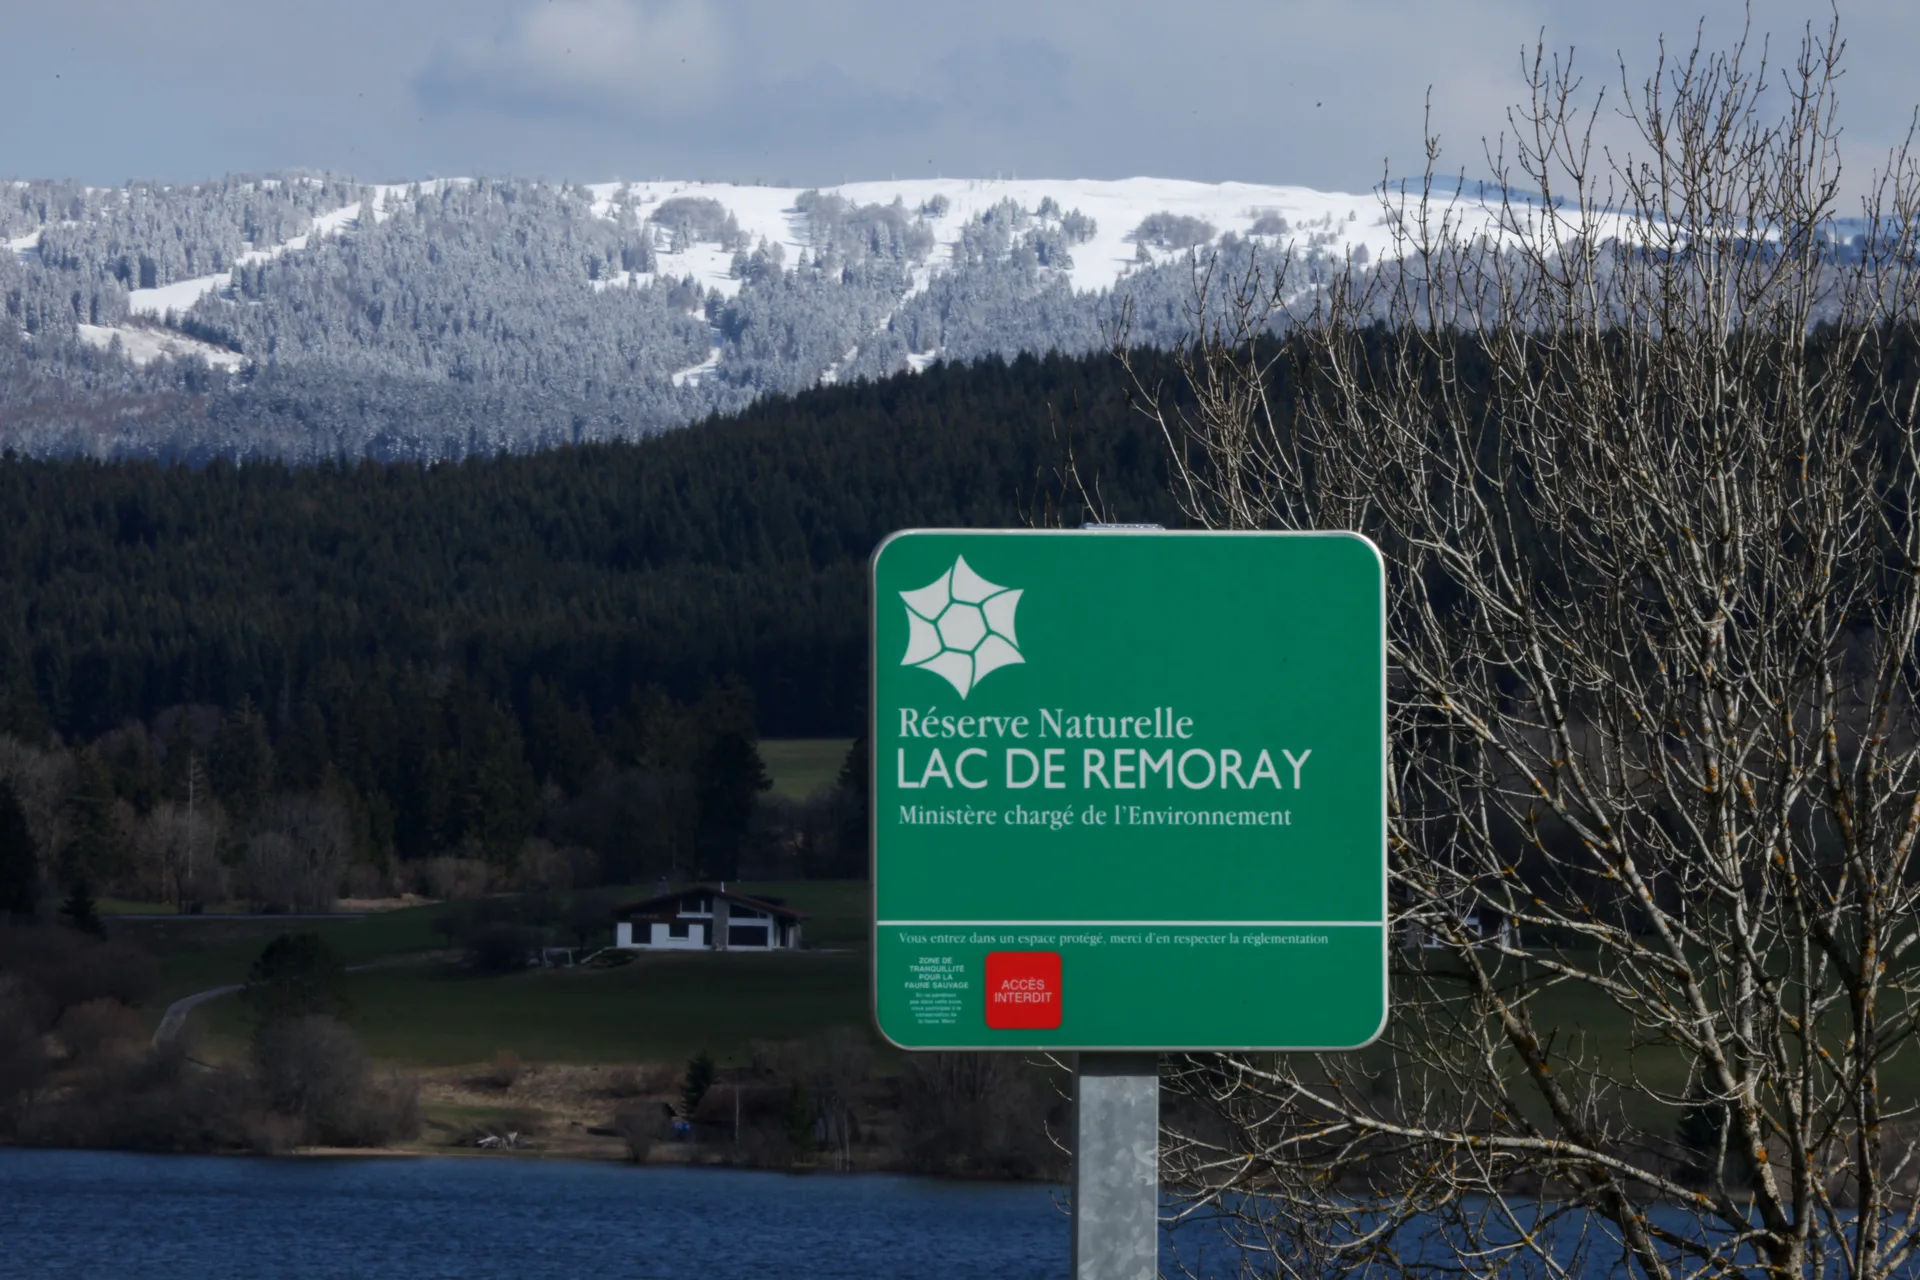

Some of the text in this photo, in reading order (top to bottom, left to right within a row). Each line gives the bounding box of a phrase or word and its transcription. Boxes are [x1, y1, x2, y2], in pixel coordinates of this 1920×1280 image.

[898, 706, 1194, 739] Réserve Naturelle
[897, 747, 1312, 790] LAC DE REMORAY
[898, 804, 997, 826] Ministère
[1004, 804, 1074, 830] chargé
[1081, 804, 1107, 826] de
[899, 932, 928, 944] Vous
[930, 935, 966, 944] entrez
[969, 932, 996, 944] dans
[1000, 935, 1014, 944] un
[1018, 935, 1056, 947] espace
[1110, 932, 1142, 944] merci
[1174, 934, 1226, 947] respecter
[1229, 932, 1239, 944] la
[1242, 932, 1329, 947] réglementation
[918, 973, 953, 981] POUR LA
[1001, 977, 1045, 991] ACCÈS
[904, 981, 969, 989] FAUNE SAUVAGE
[994, 992, 1053, 1003] INTERDIT
